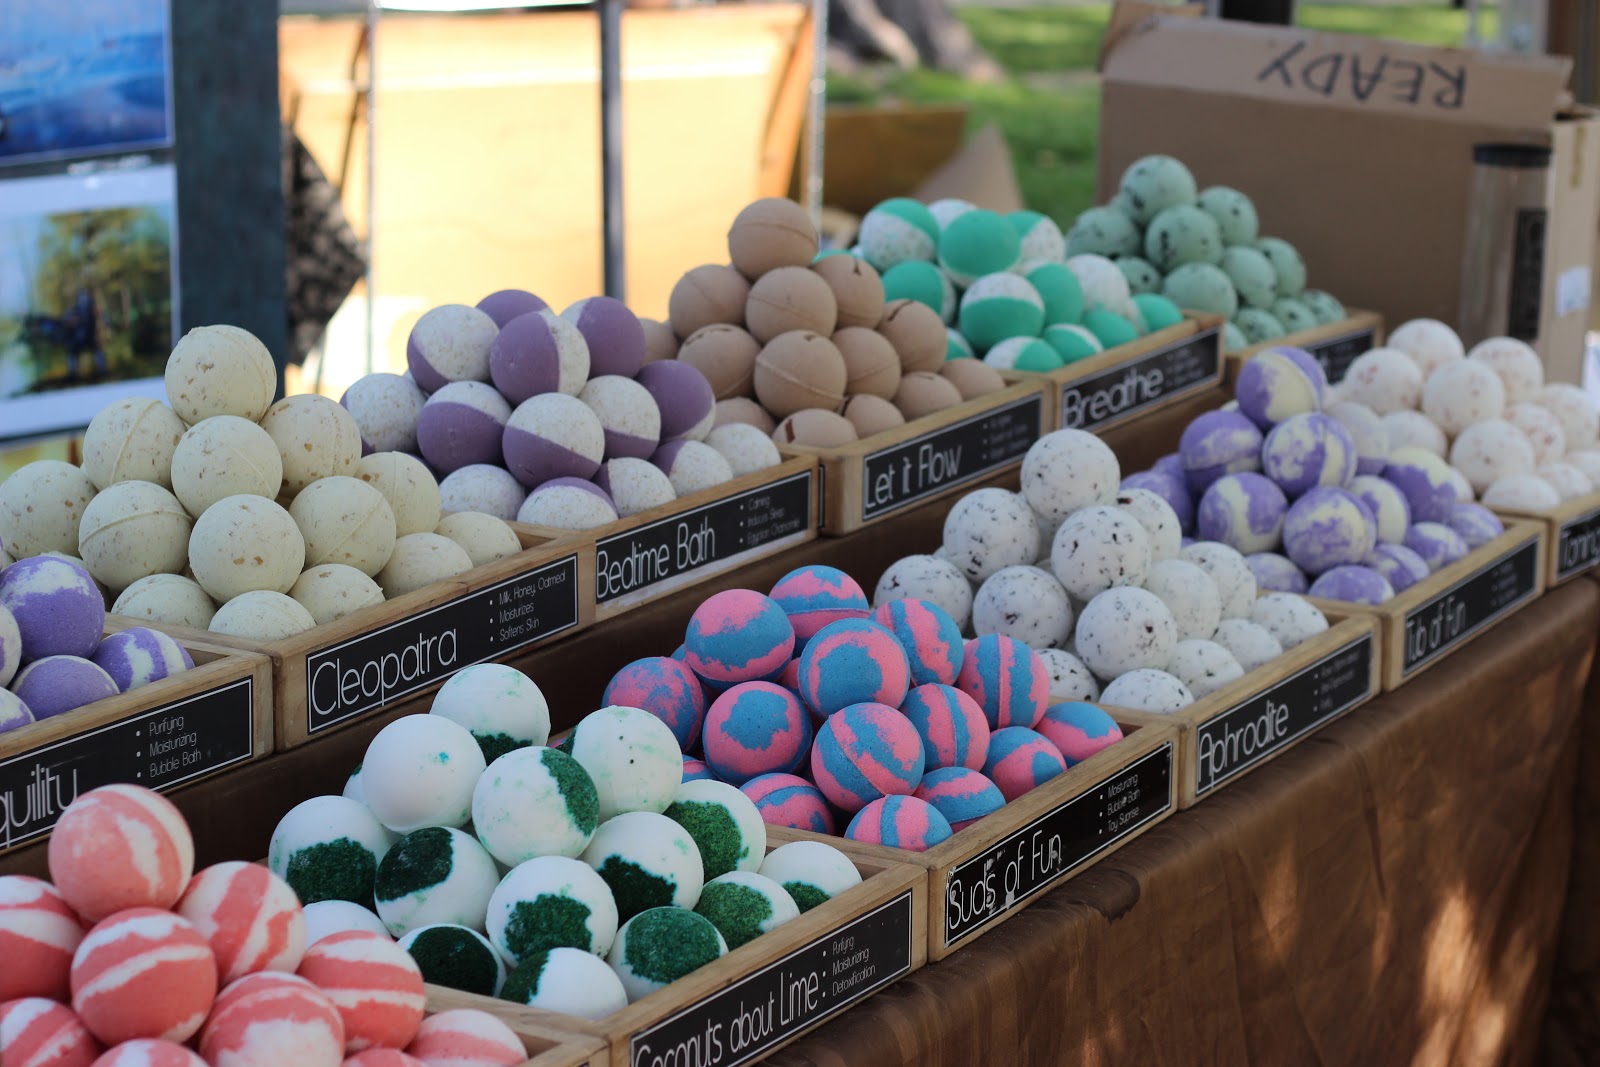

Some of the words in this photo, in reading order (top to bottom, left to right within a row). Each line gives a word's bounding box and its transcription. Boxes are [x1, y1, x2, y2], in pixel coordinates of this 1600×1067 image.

[1257, 40, 1467, 110] READY
[1062, 367, 1164, 430] Breathe
[864, 463, 896, 509] Let
[918, 442, 963, 489] Flow
[596, 541, 670, 599] Bedtime
[676, 515, 716, 570] Bath
[537, 569, 566, 590] Oatmeal
[499, 602, 535, 624] Moisturizes
[499, 624, 525, 642] Softens
[526, 617, 541, 632] Skin
[311, 627, 458, 716] Cleopatra
[149, 716, 184, 737] Purifying
[149, 732, 197, 758] Moisturizing
[1198, 699, 1290, 790] Aphrodite
[149, 756, 180, 778] Bubble
[182, 747, 202, 767] Bath
[1107, 819, 1119, 833] Toy
[948, 862, 997, 930] Suds
[1004, 840, 1026, 894] of
[1031, 829, 1063, 881] Fun
[832, 936, 855, 956] Purifying
[832, 947, 870, 977] Moisturizing
[832, 964, 876, 997] Detoxification
[729, 991, 775, 1054] about
[779, 971, 819, 1027] Lime
